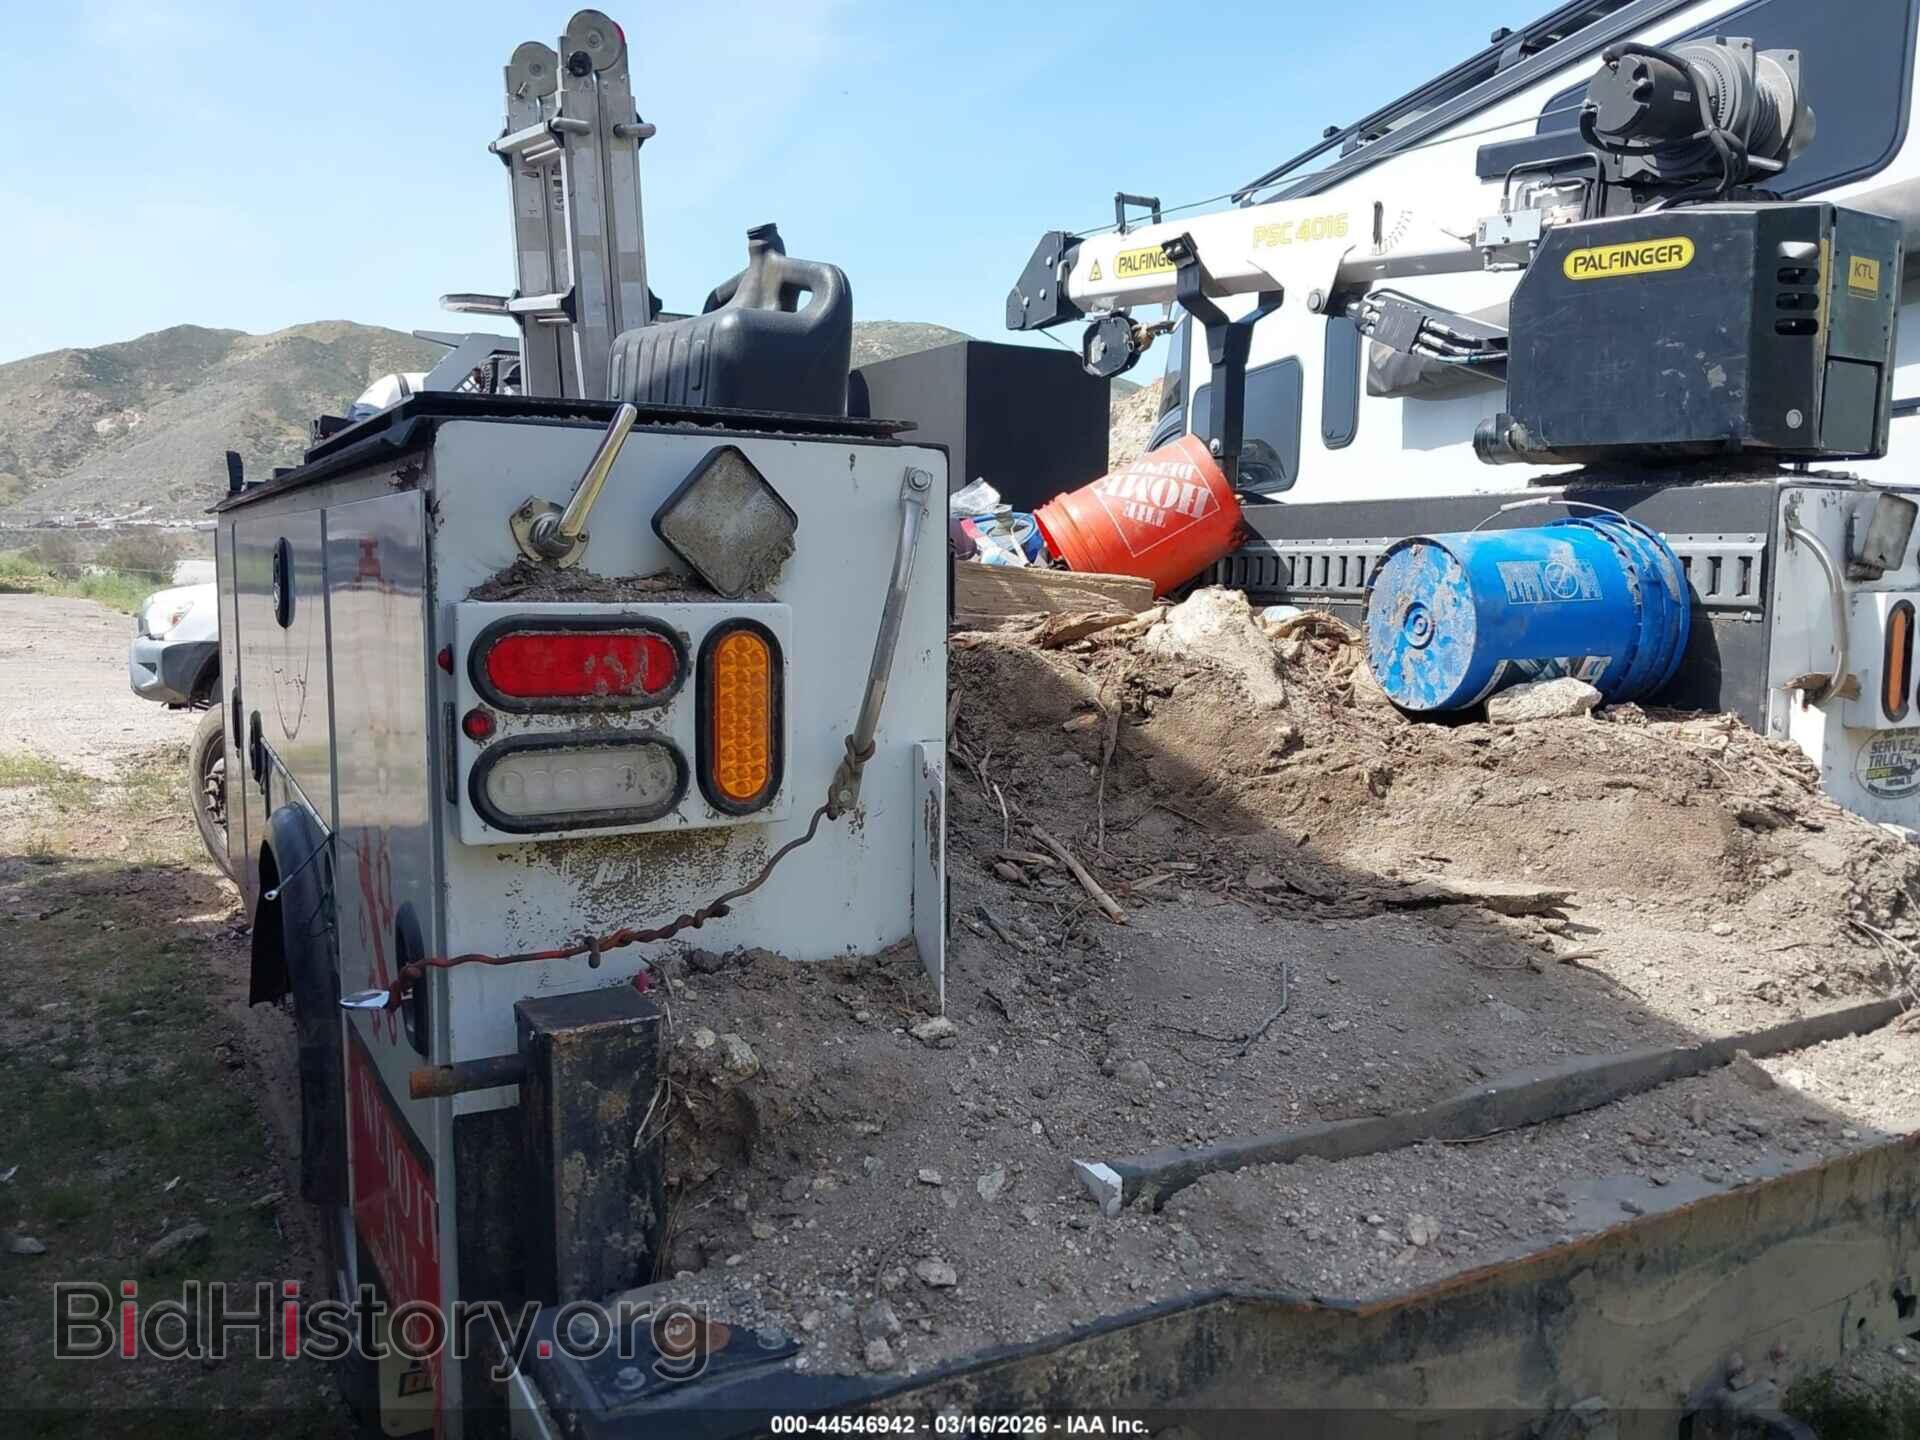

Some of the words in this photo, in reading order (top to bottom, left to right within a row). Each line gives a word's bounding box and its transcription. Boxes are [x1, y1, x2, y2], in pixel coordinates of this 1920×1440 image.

[1253, 223, 1293, 248] PSC
[1296, 213, 1348, 239] 4016
[1573, 244, 1684, 274] PALFINGER
[1853, 263, 1874, 280] KTL
